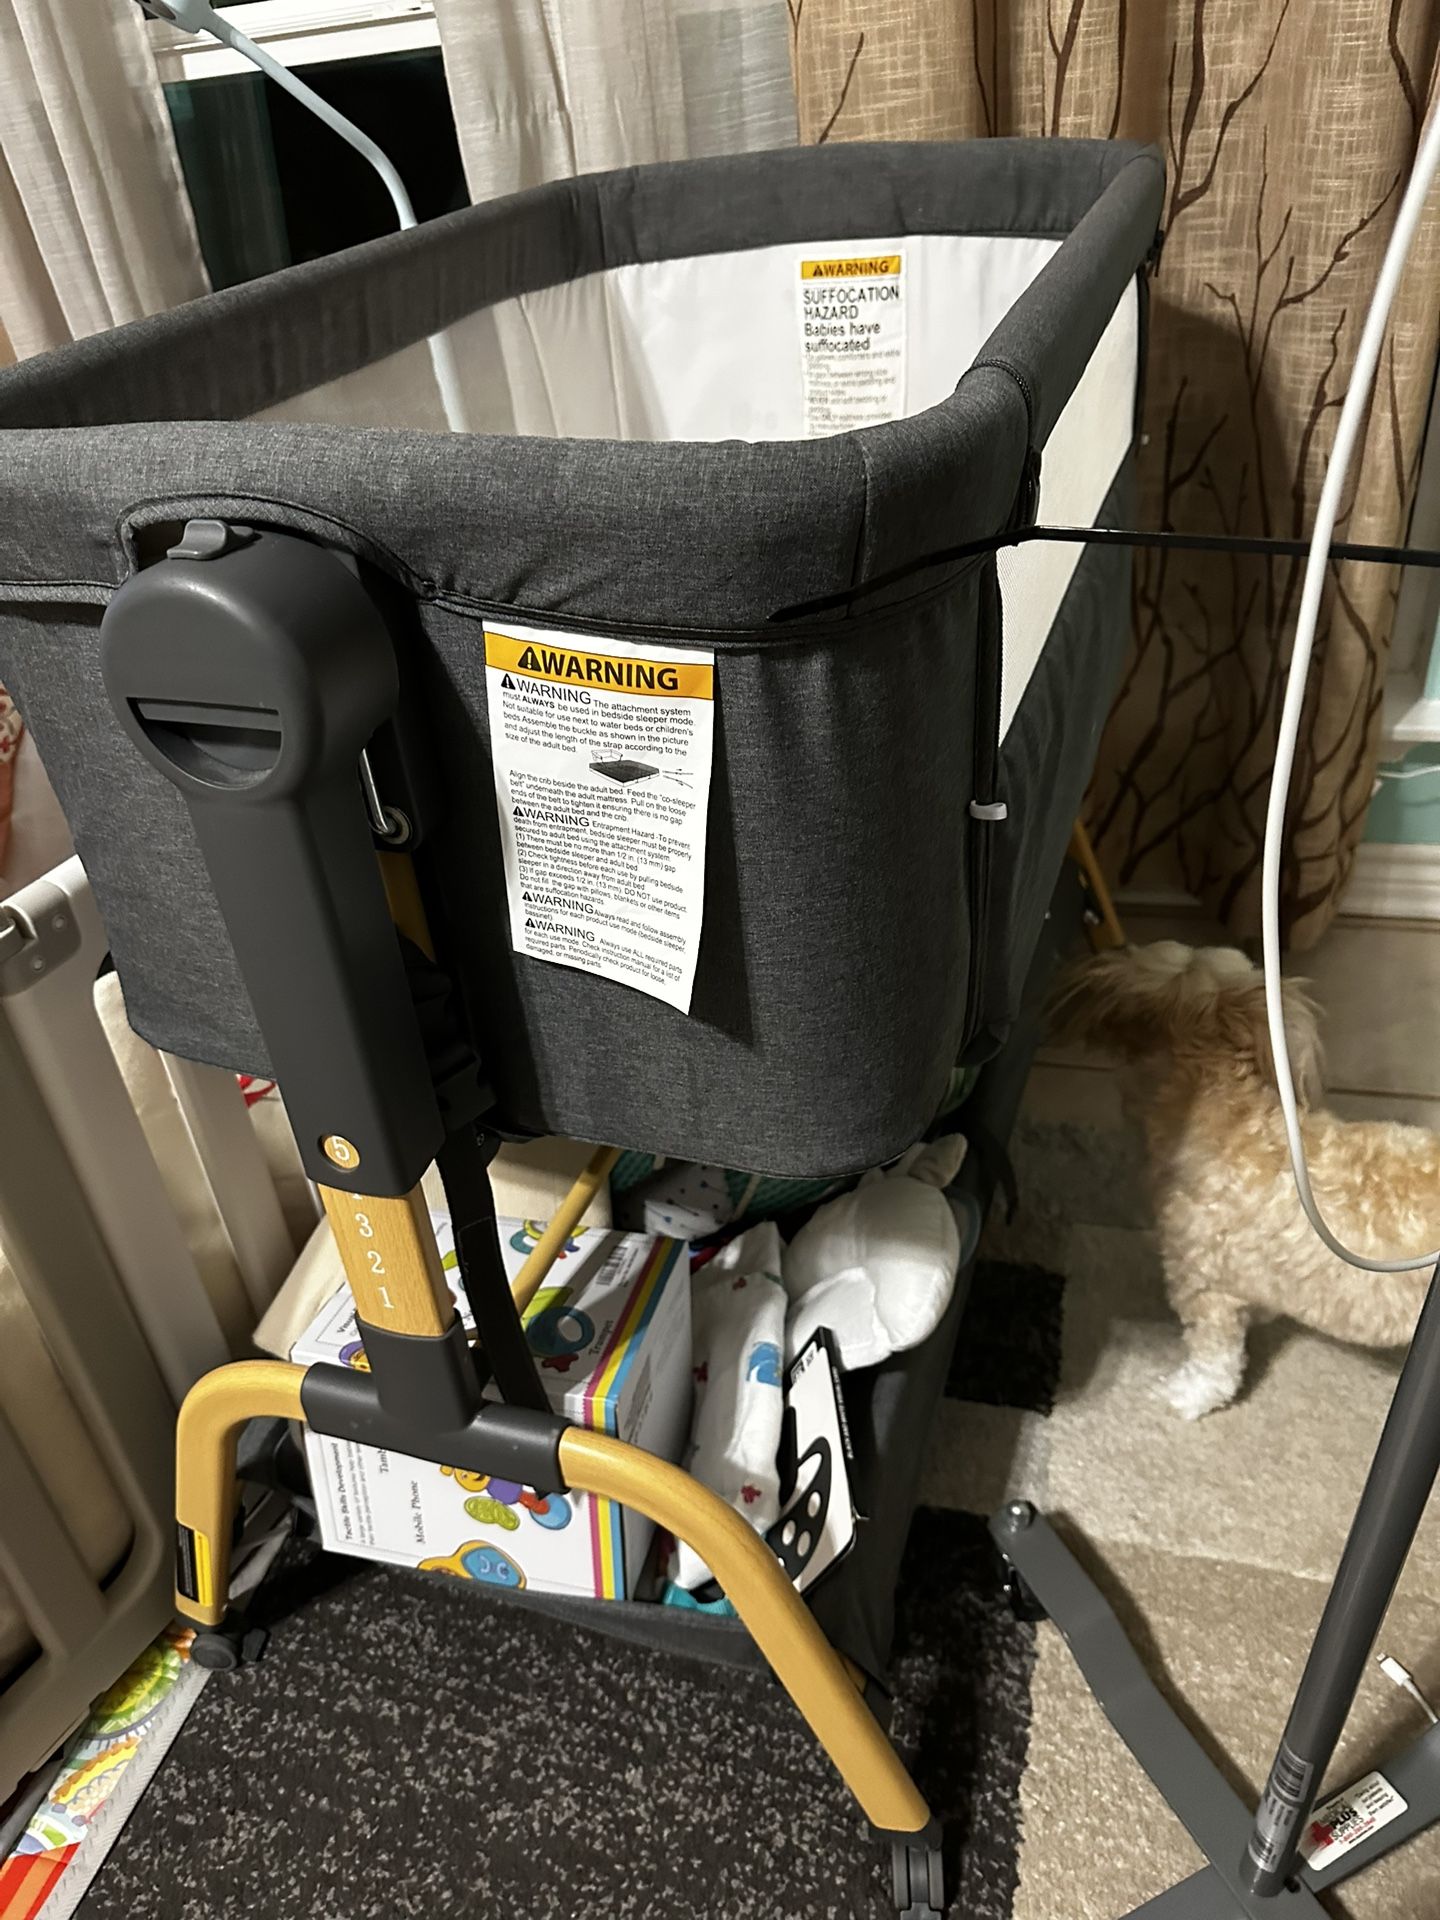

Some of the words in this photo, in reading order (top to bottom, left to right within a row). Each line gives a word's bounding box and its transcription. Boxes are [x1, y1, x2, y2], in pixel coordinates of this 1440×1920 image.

[823, 261, 889, 277] WARNING
[803, 285, 899, 305] SUFFOCATION
[804, 305, 859, 321] HAZARD
[804, 323, 845, 336] Babies
[849, 321, 881, 335] have
[805, 337, 871, 353] suffocated
[540, 649, 679, 691] WARNING
[502, 691, 521, 701] must
[522, 695, 555, 708] ALWAYS
[557, 703, 568, 711] be
[570, 706, 590, 715] used
[601, 710, 633, 721] bedside
[635, 714, 667, 724] sleeper
[517, 679, 591, 704] WARNING
[593, 699, 609, 709] The
[611, 703, 658, 714] attachment
[660, 708, 691, 719] system
[502, 700, 515, 709] Not
[516, 705, 543, 716] suitable
[545, 710, 555, 719] for
[556, 714, 571, 722] use
[572, 716, 589, 724] next
[599, 721, 621, 729] water
[623, 722, 643, 731] beds
[655, 725, 693, 736] children's
[521, 715, 557, 729] Assemble
[558, 723, 571, 732] the
[572, 726, 597, 736] buckle
[598, 730, 608, 738] as
[610, 732, 636, 740] shown
[647, 734, 660, 742] the
[662, 736, 688, 746] picture
[504, 722, 517, 731] and
[519, 726, 540, 736] adjust
[541, 730, 553, 738] the
[554, 732, 578, 743] length
[588, 738, 601, 747] the
[602, 741, 623, 750] strap
[624, 743, 663, 754] according
[674, 747, 687, 756] the
[505, 732, 519, 741] size
[528, 737, 541, 746] the
[542, 741, 560, 749] adult
[509, 769, 526, 780] Align
[526, 773, 538, 782] the
[538, 777, 552, 785] crib
[552, 779, 576, 789] beside
[576, 783, 588, 791] the
[626, 788, 645, 798] Feed
[646, 792, 658, 800] the
[510, 788, 527, 797] ends
[536, 793, 547, 801] the
[548, 795, 561, 804] belt
[570, 799, 595, 808] tighten
[601, 804, 632, 815] ensuring
[633, 807, 651, 817] there
[669, 816, 682, 825] gap
[511, 796, 539, 807] between
[540, 802, 552, 810] the
[553, 805, 570, 813] adult
[571, 807, 585, 815] bed
[601, 811, 613, 819] the
[525, 783, 563, 795] underneath
[564, 790, 576, 798] the
[577, 792, 595, 800] adult
[630, 797, 644, 806] Pull
[655, 803, 667, 812] the
[668, 805, 686, 816] loose
[523, 807, 590, 827] WARNING
[592, 820, 630, 833] Entrapment
[631, 828, 654, 839] Hazard
[513, 816, 531, 825] death
[532, 819, 548, 828] from
[589, 828, 615, 840] bedside
[616, 834, 640, 844] sleeper
[641, 840, 657, 849] must
[658, 843, 667, 852] be
[667, 847, 691, 861] properly
[514, 825, 540, 835] secured
[549, 831, 565, 839] adult
[566, 833, 580, 841] bed
[580, 836, 598, 846] using
[599, 839, 610, 847] the
[611, 842, 646, 855] attachment
[515, 832, 525, 841] (1)
[526, 833, 545, 843] There
[563, 840, 572, 848] be
[583, 845, 599, 853] more
[600, 848, 615, 856] than
[648, 860, 663, 870] mm)
[664, 864, 676, 873] gap
[516, 840, 544, 850] between
[545, 845, 570, 855] bedside
[571, 851, 594, 860] sleeper
[595, 856, 608, 864] and
[609, 859, 625, 867] adult
[518, 857, 541, 866] sleeper
[555, 864, 582, 874] direction
[583, 870, 600, 880] away
[601, 873, 615, 882] from
[616, 878, 631, 887] adult
[527, 850, 548, 859] Check
[549, 854, 577, 866] tightness
[578, 860, 599, 870] before
[600, 865, 616, 873] each
[638, 875, 659, 887] pulling
[659, 880, 683, 893] bedside
[548, 871, 575, 881] exceeds
[624, 887, 635, 896] DO
[636, 890, 650, 900] NOT
[533, 893, 594, 914] WARNING
[594, 909, 615, 920] Always
[535, 920, 595, 942] WARNING
[331, 1135, 350, 1161] 5
[355, 1213, 374, 1238] 3
[367, 1250, 386, 1274] 2
[378, 1286, 395, 1308] 1
[330, 1442, 346, 1493] Development
[339, 1494, 350, 1514] Skills
[410, 1480, 422, 1510] Phone
[343, 1515, 353, 1541] Tactile
[413, 1511, 426, 1545] Mobile
[1329, 1807, 1358, 1830] PLUS
[1331, 1816, 1365, 1841] SUPPLIES
